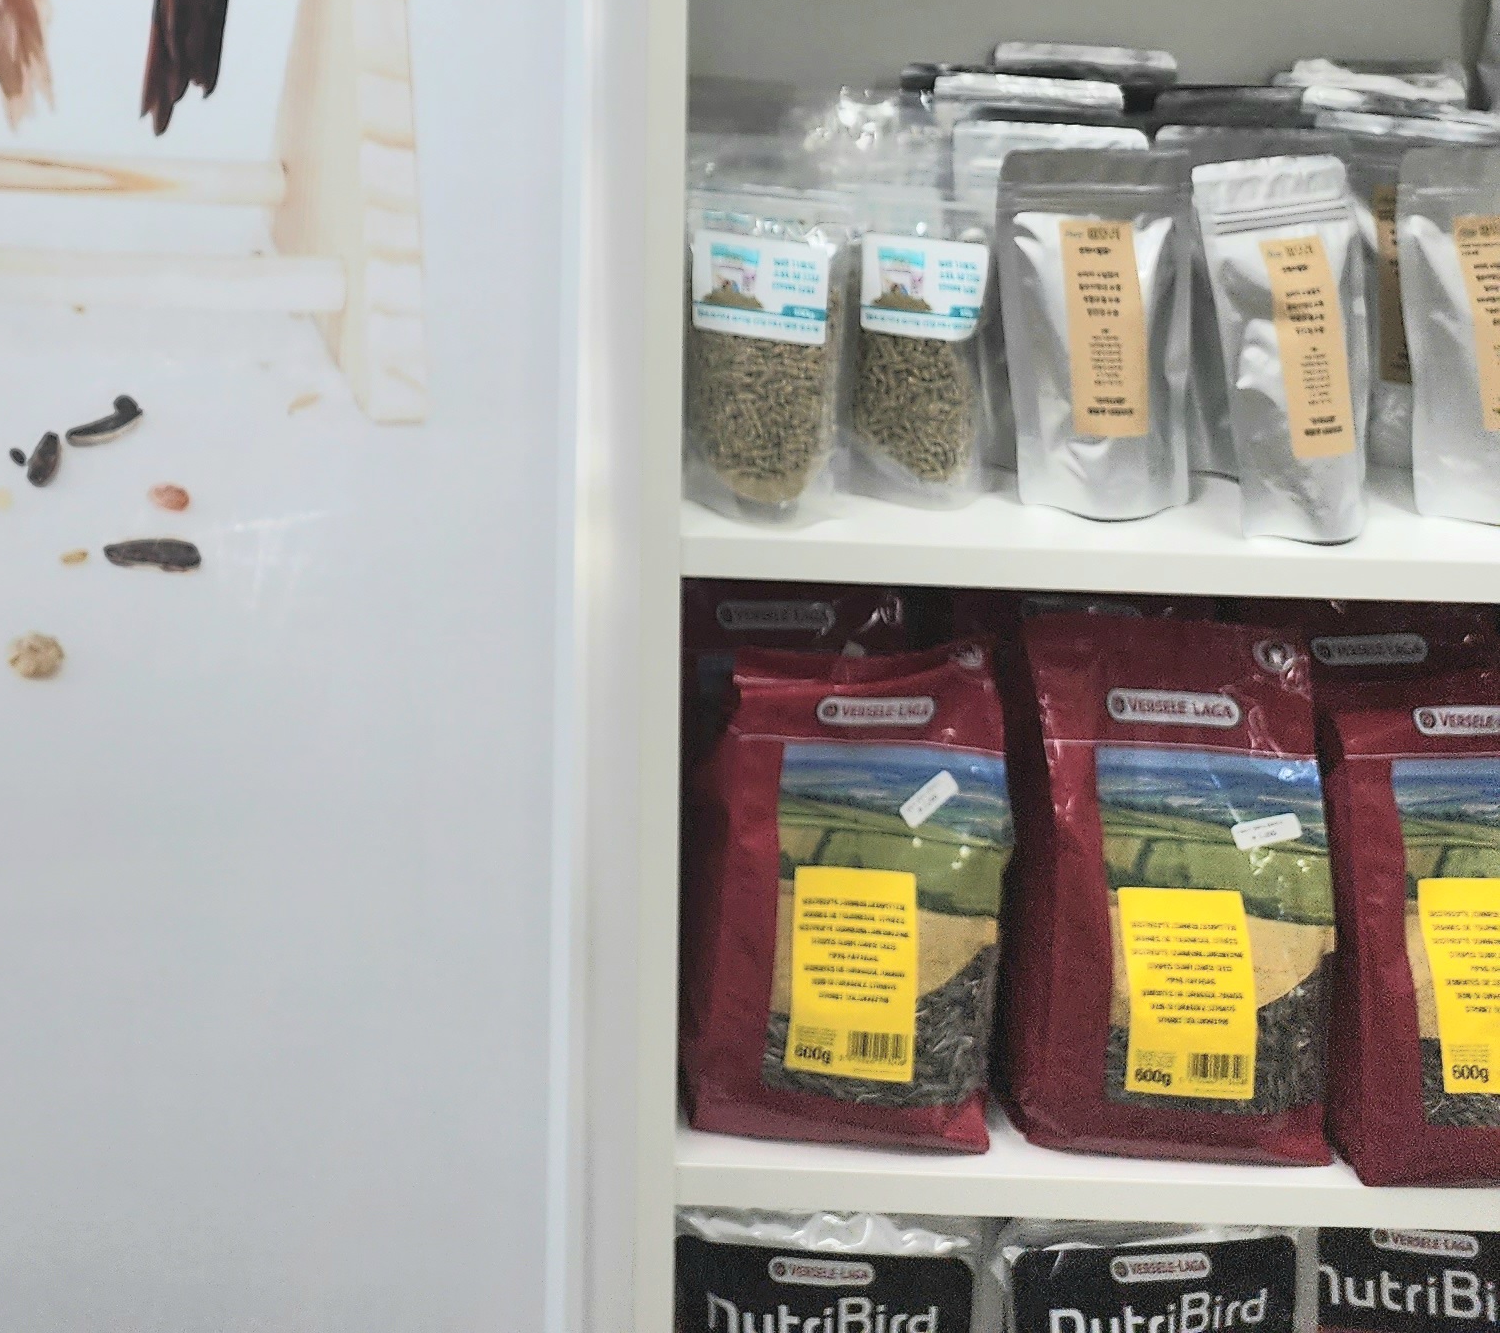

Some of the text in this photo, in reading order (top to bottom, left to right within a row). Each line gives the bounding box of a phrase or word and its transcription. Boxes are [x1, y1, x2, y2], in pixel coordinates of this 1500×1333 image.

[793, 1044, 832, 1065] 600g
[1134, 1067, 1173, 1087] 600g
[1451, 1064, 1490, 1083] 600g
